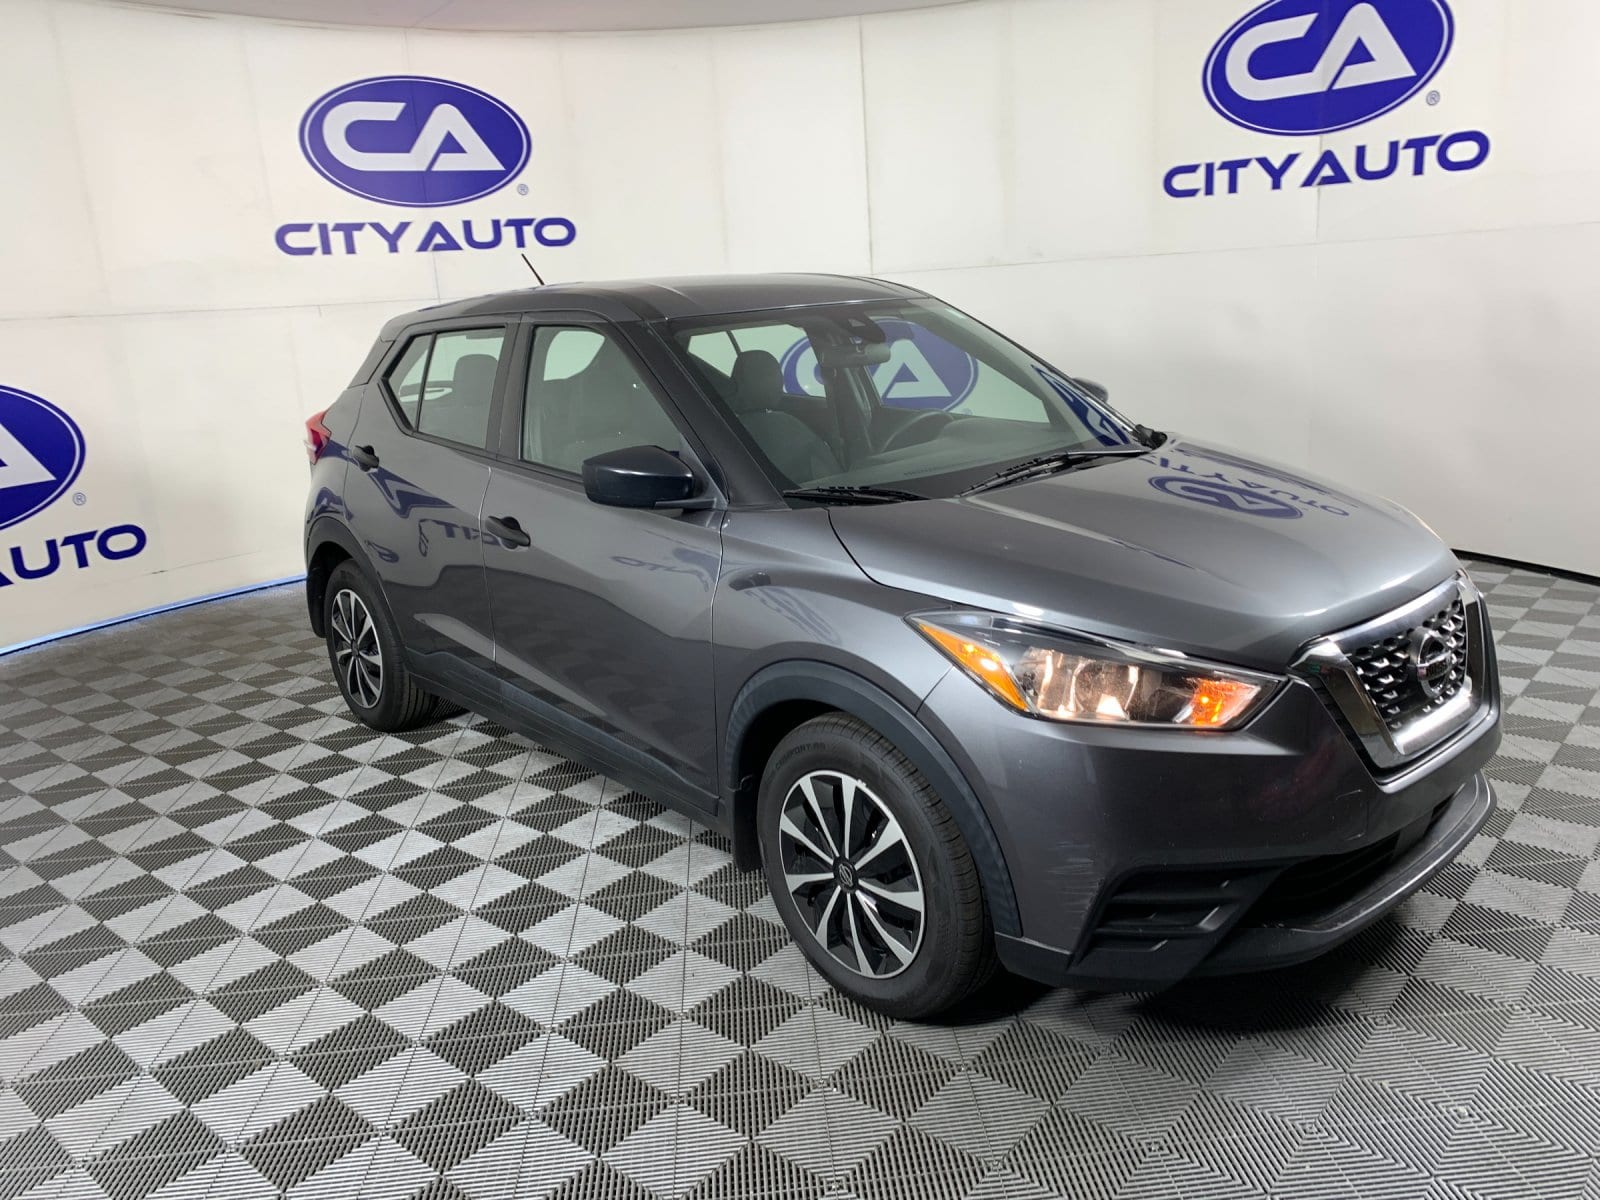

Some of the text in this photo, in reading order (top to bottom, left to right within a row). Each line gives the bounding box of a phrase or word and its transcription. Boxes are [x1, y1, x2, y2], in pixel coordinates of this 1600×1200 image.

[1225, 2, 1417, 101] CA
[322, 101, 506, 171] CA
[1163, 130, 1490, 198] CITY AUTO
[275, 217, 576, 255] CITY AUTO
[0, 524, 147, 588] UTO
